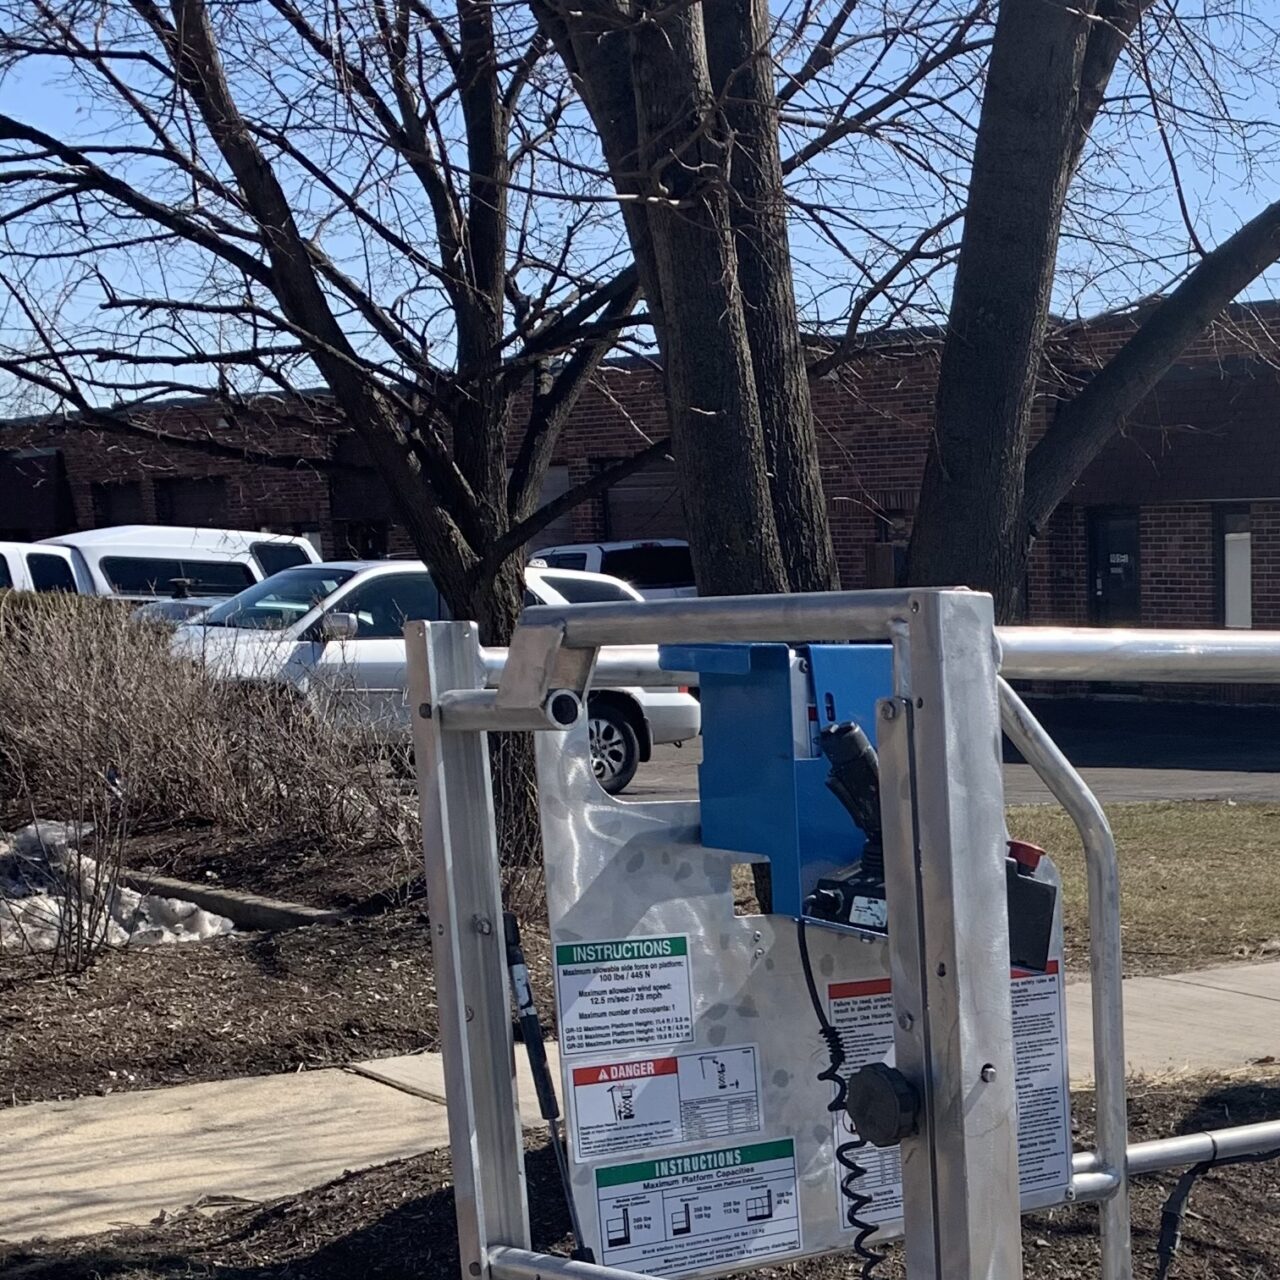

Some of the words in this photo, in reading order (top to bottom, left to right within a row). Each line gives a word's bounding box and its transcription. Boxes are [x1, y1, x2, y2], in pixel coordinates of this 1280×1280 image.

[573, 940, 671, 962] INSTRUCTIONS
[562, 968, 591, 976] Maximum
[592, 965, 620, 974] allowable
[634, 962, 649, 970] force
[659, 960, 684, 970] platform:
[630, 971, 643, 979] 445
[645, 970, 651, 978] N
[578, 989, 607, 997] Maximum
[608, 986, 636, 995] allowable
[652, 983, 672, 993] speed:
[590, 997, 606, 1005] 12.5
[607, 995, 629, 1004] m/sec
[646, 991, 663, 1001] mph
[578, 1011, 607, 1020] Maximum
[608, 1008, 631, 1017] number
[632, 1007, 639, 1015] of
[639, 1004, 671, 1015] occupants:
[583, 1023, 610, 1032] Maximum
[611, 1021, 634, 1029] Platform
[635, 1019, 654, 1028] Height:
[584, 1032, 611, 1040] Maximum
[612, 1029, 634, 1037] Platform
[636, 1027, 655, 1035] Height:
[585, 1040, 611, 1048] Maximum
[612, 1037, 635, 1045] Platform
[636, 1035, 655, 1043] Height:
[610, 1062, 655, 1079] DANGER
[655, 1149, 742, 1177] INSTRUCTIONS
[642, 1179, 679, 1190] Maximum
[682, 1172, 714, 1184] Platform
[716, 1167, 755, 1179] Capacities
